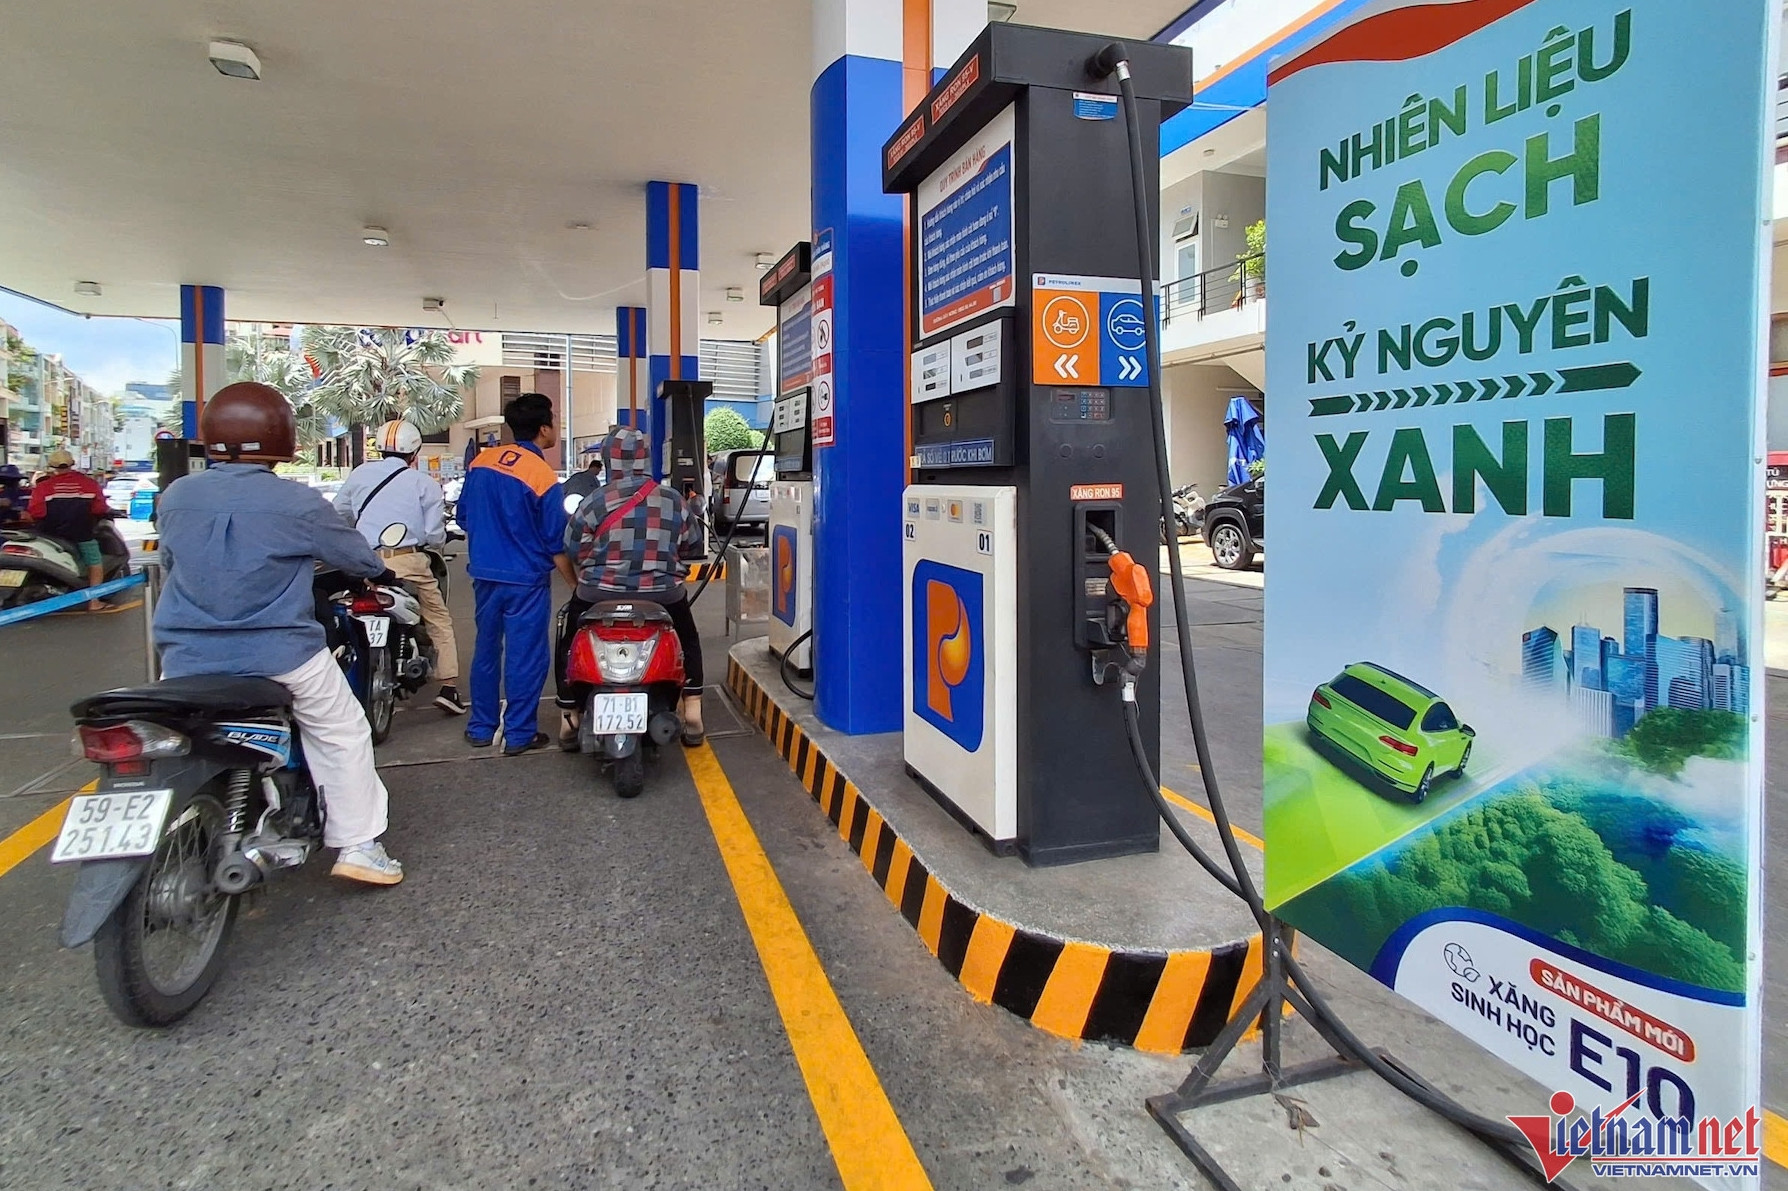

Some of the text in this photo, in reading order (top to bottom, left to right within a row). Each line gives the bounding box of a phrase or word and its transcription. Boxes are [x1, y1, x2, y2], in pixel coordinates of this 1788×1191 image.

[1319, 8, 1631, 191] NHIÊN LIỆU
[1333, 112, 1600, 277] SẠCH
[1307, 274, 1649, 384] KỶ NGUYÊN
[1313, 412, 1637, 520] XANH
[908, 502, 920, 513] VISA
[1072, 487, 1120, 500] XĂNG RON 95
[905, 523, 914, 538] 02
[979, 533, 990, 552] 01
[227, 731, 279, 743] BLADE
[79, 794, 155, 824] 59-E2
[60, 823, 152, 856] 251.43
[1451, 983, 1556, 1057] SINH HỌC
[1489, 975, 1556, 1028] XĂNG
[1540, 967, 1685, 1055] SẢN PHẨM MỚI
[1569, 1017, 1696, 1135] E10
